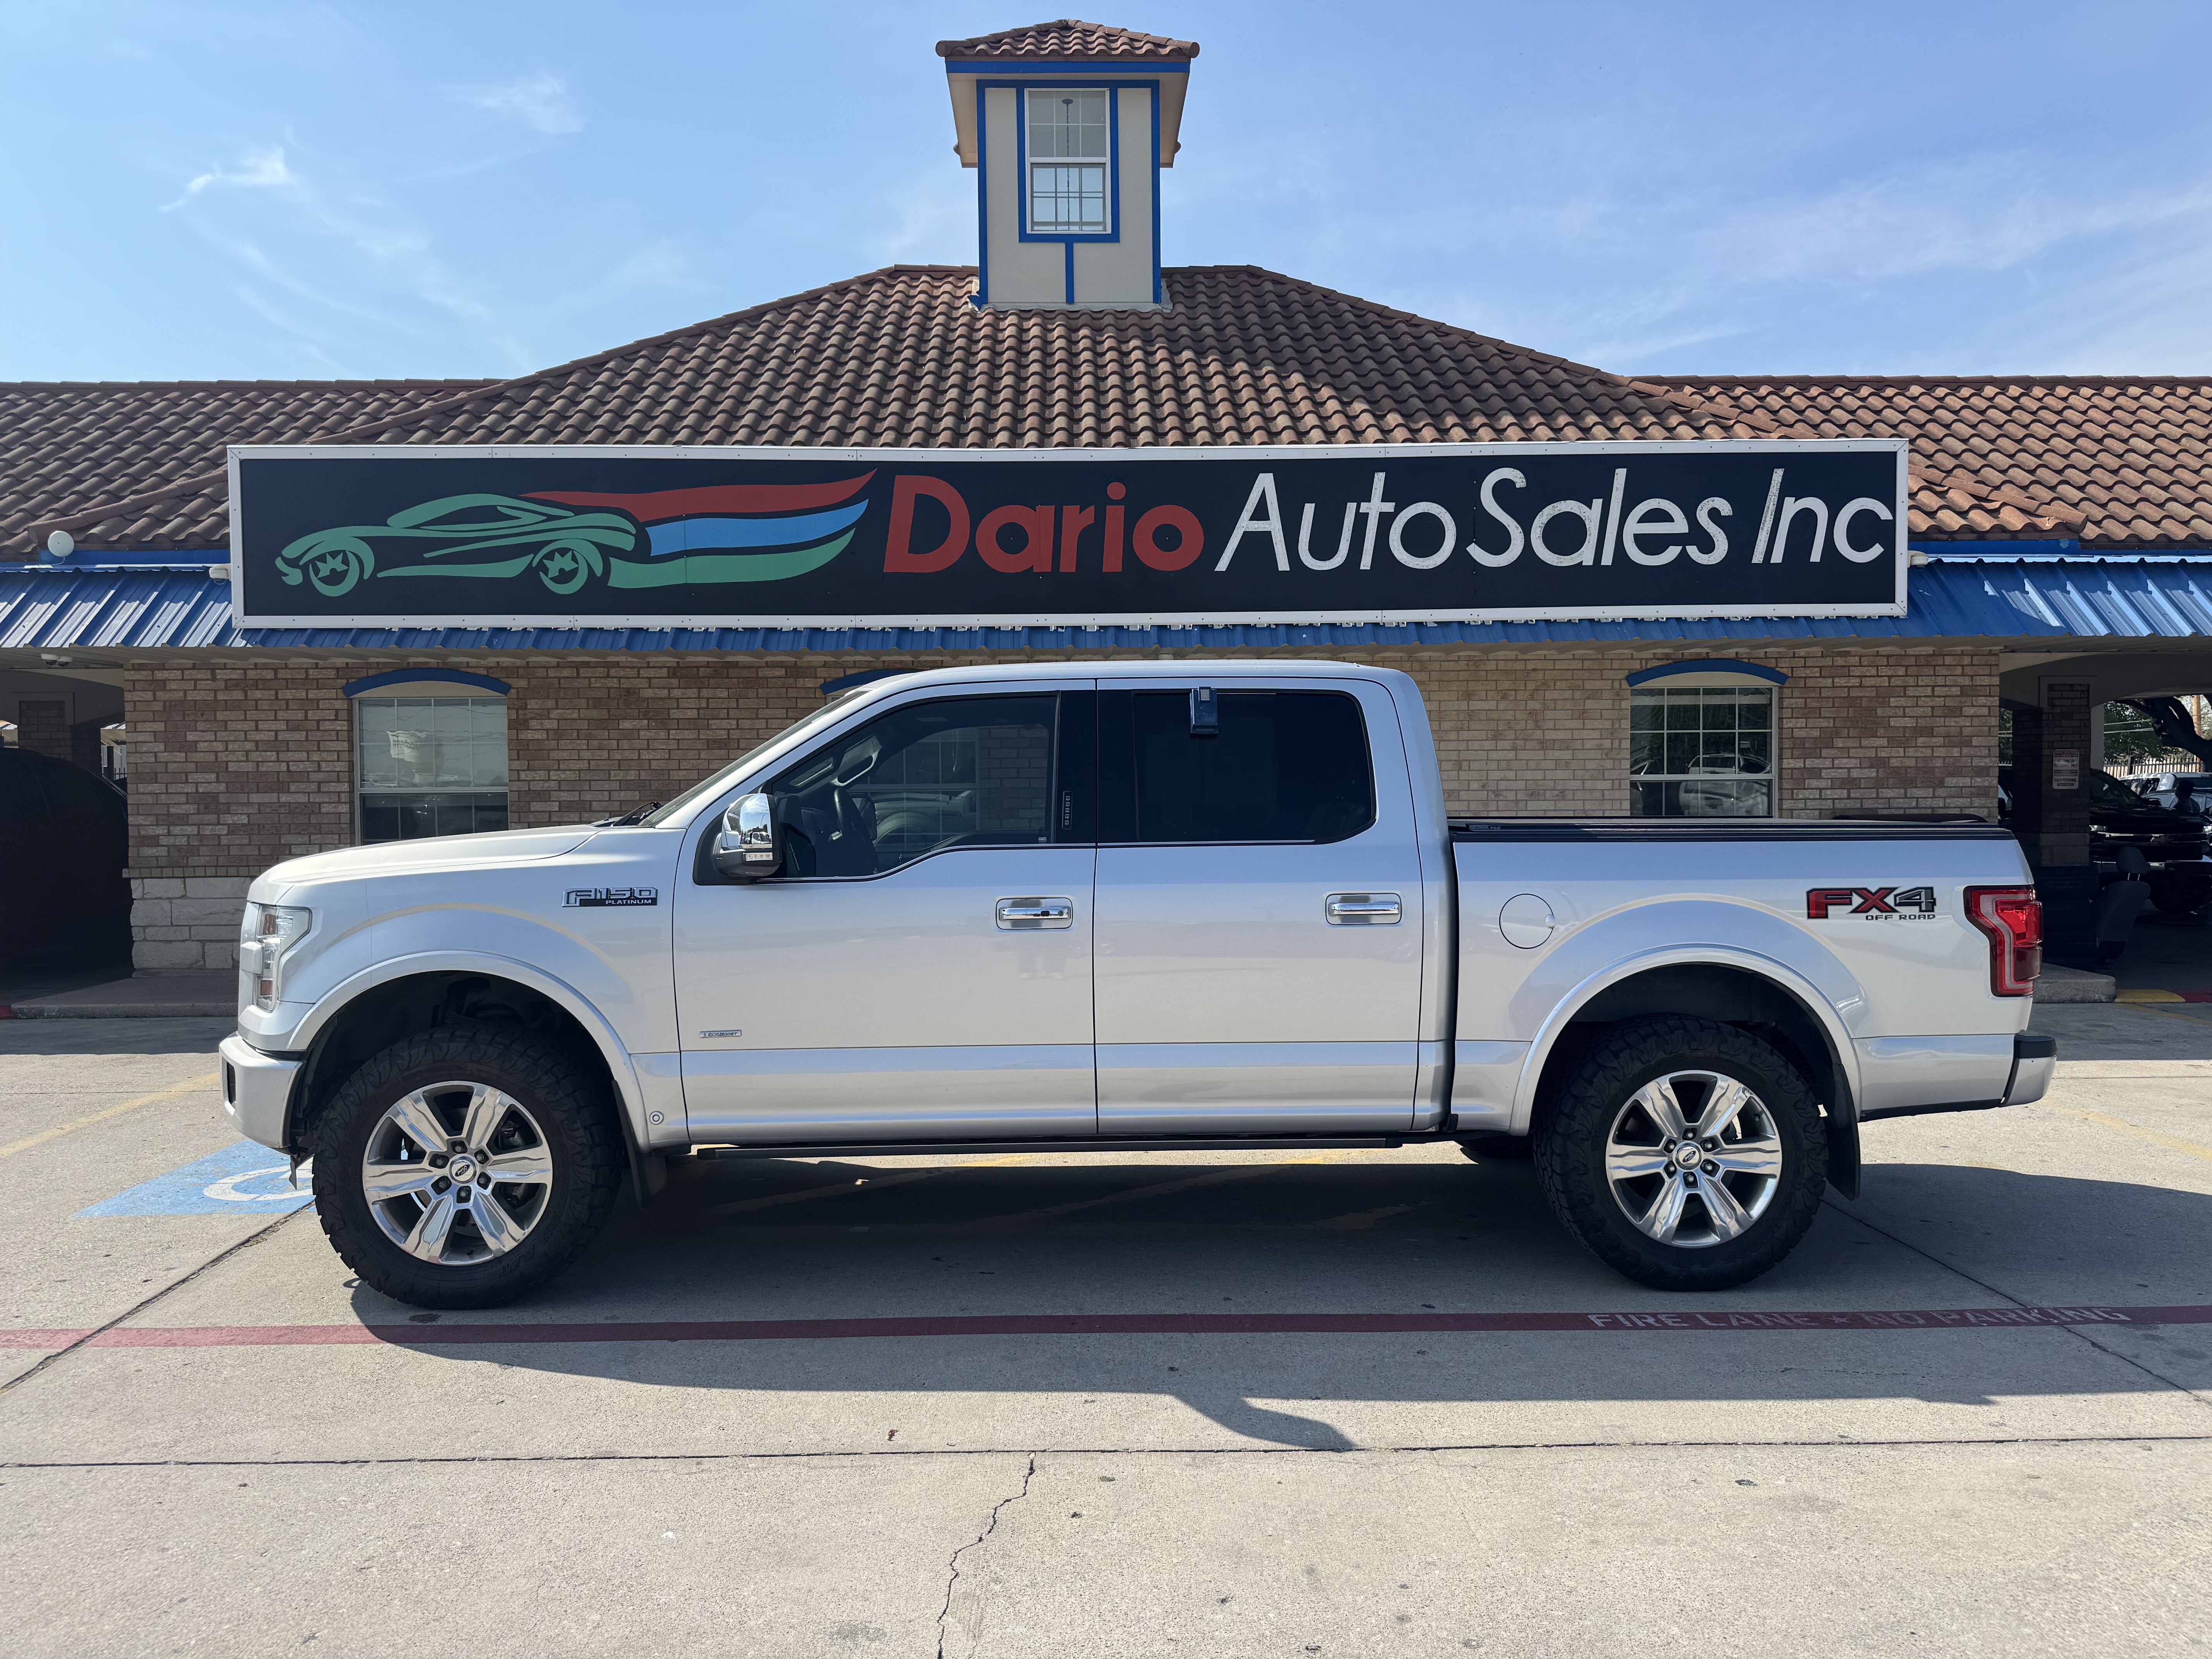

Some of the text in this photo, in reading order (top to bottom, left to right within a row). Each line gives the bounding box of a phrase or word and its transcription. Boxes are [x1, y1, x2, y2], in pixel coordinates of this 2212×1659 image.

[883, 467, 1894, 573] Dario Auto Sales Inc
[1806, 886, 1936, 920] FX4
[457, 1165, 468, 1176] Ford
[1587, 1307, 2132, 1327] FIRE LANE NO PARKING
